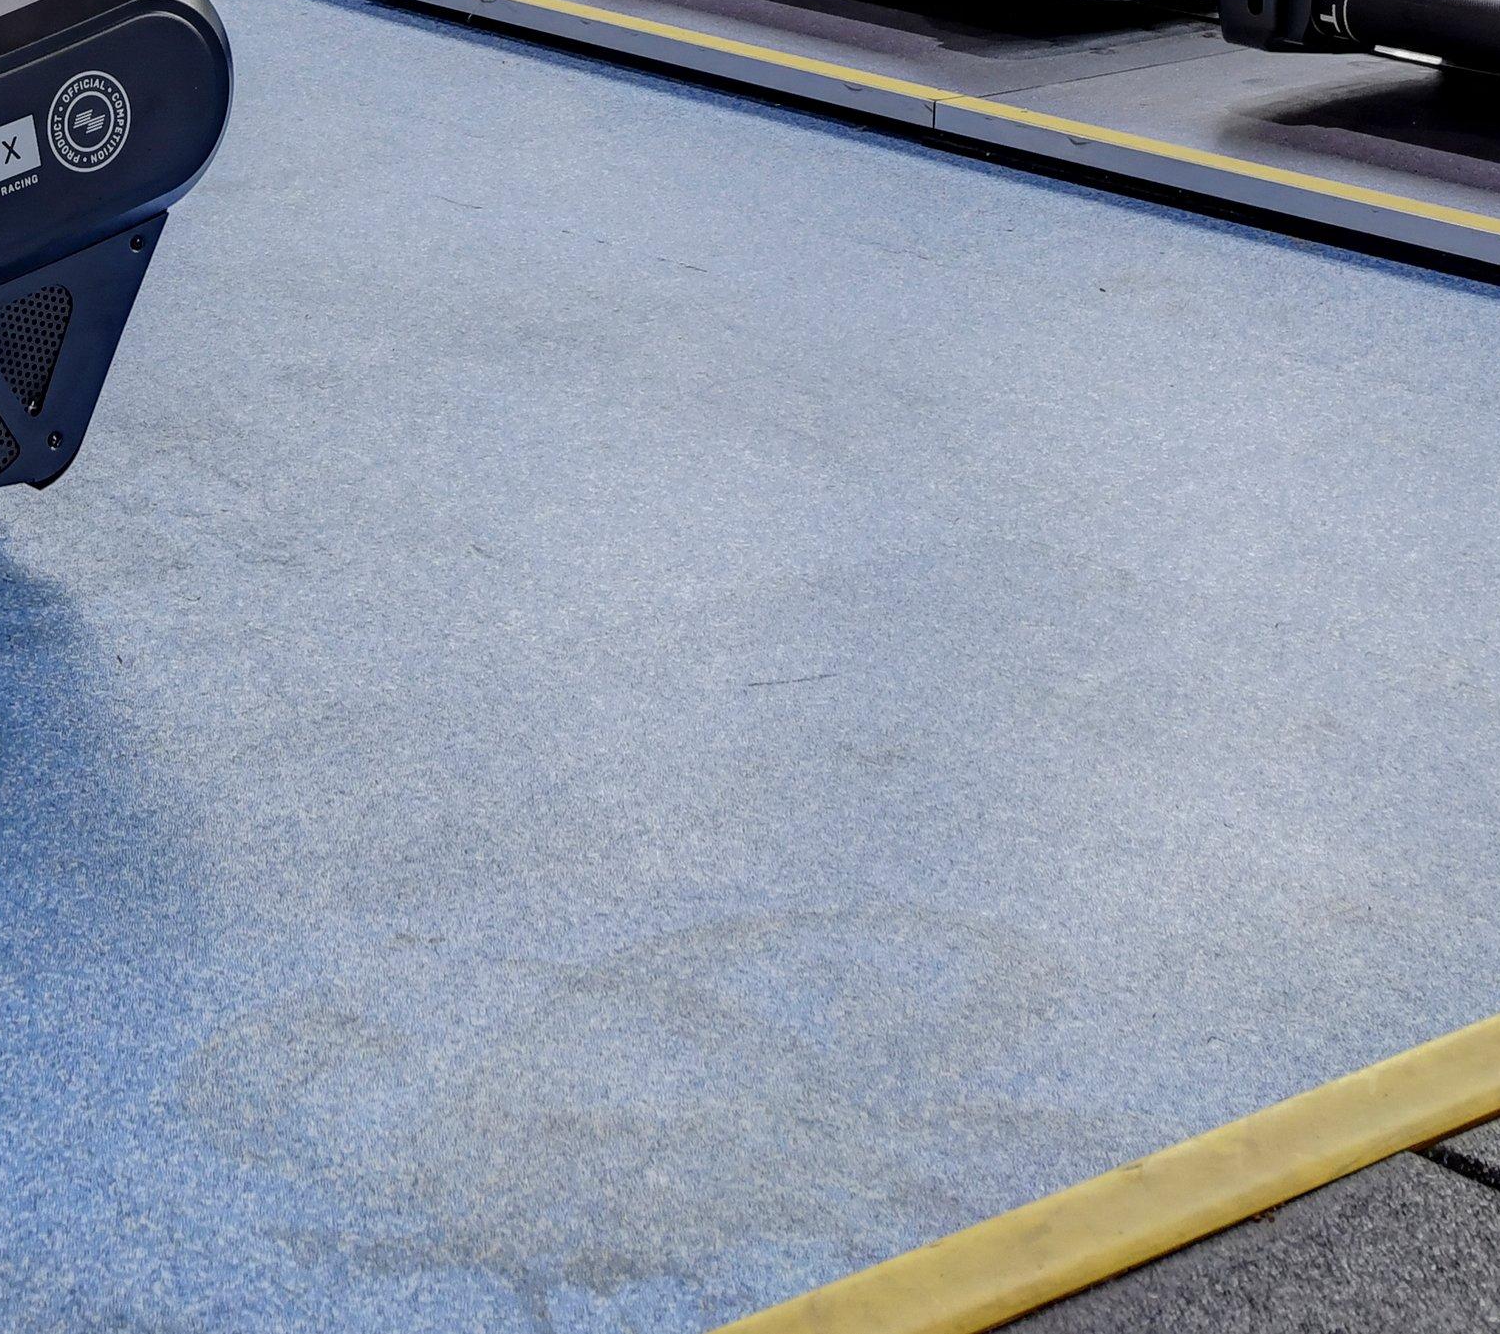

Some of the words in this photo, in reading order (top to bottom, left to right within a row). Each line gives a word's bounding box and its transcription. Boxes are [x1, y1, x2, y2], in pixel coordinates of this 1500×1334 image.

[61, 77, 106, 105] OFFICIAL
[52, 113, 80, 163] PRODUCT
[90, 91, 126, 165] COMPETITION
[0, 174, 40, 198] RACING
